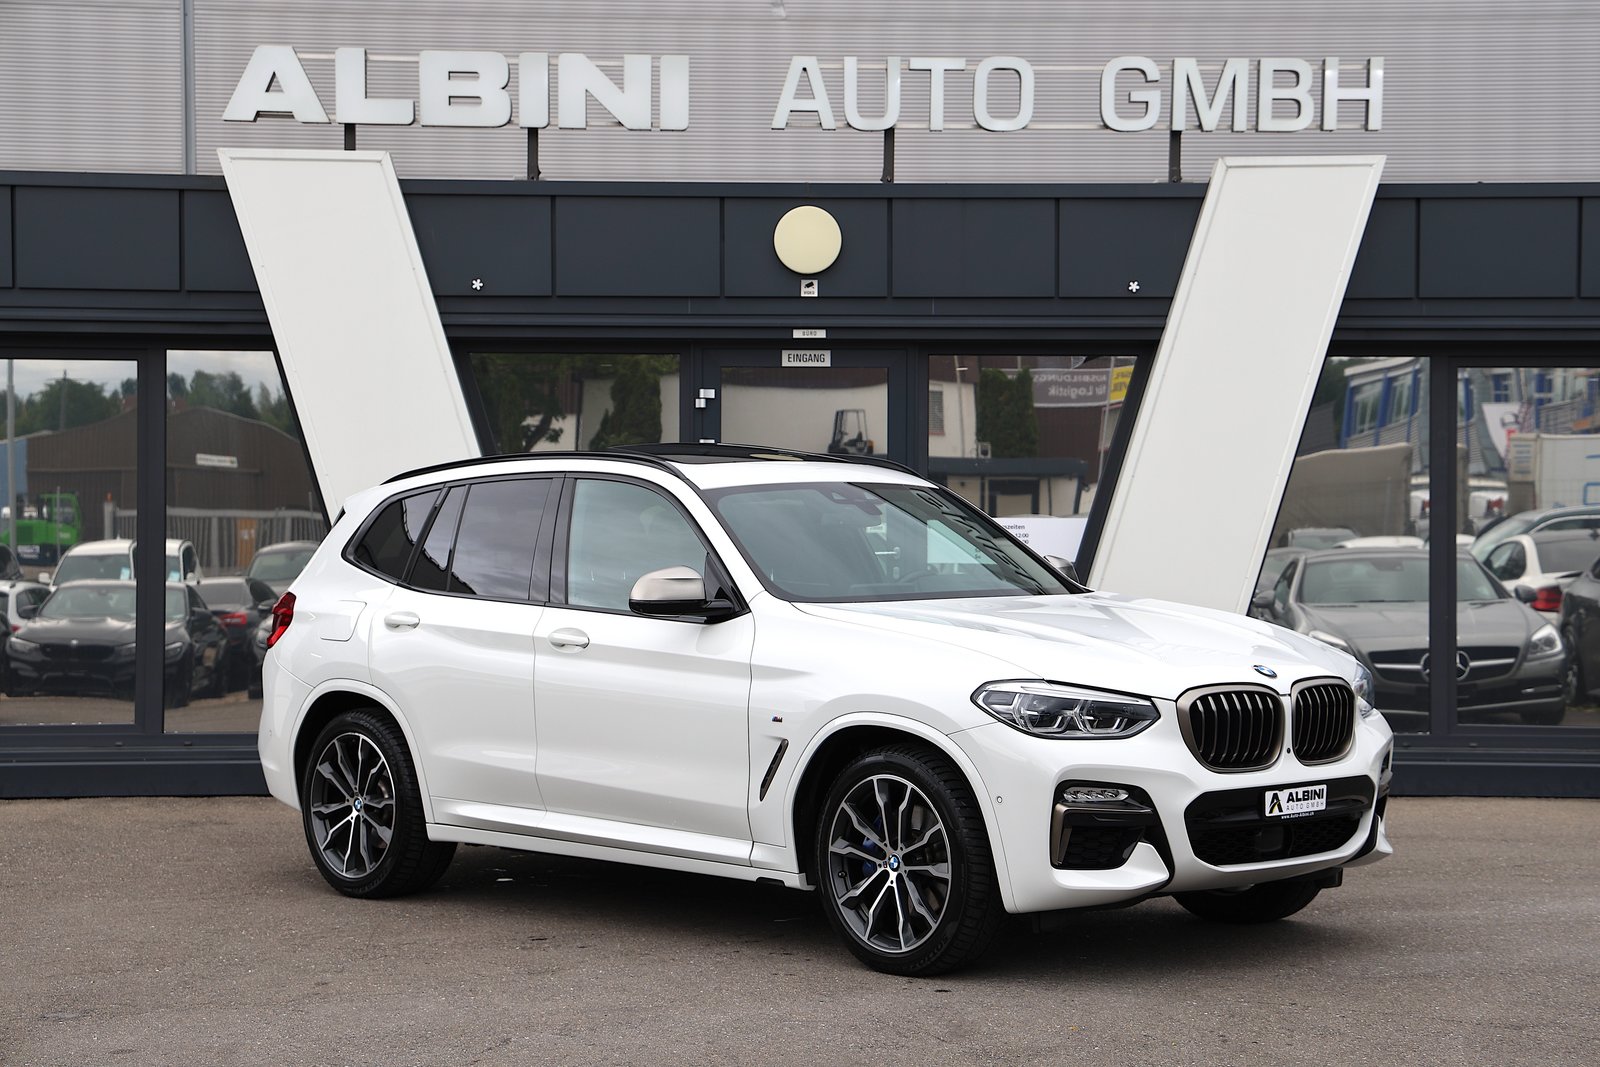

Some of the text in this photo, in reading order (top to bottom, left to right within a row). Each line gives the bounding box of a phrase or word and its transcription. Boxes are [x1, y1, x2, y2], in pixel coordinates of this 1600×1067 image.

[222, 45, 1384, 131] ALBINI AUTO GMBH
[787, 353, 825, 363] EINGANG
[1286, 788, 1324, 803] ALBINI
[1286, 801, 1324, 811] AUTO GMBH
